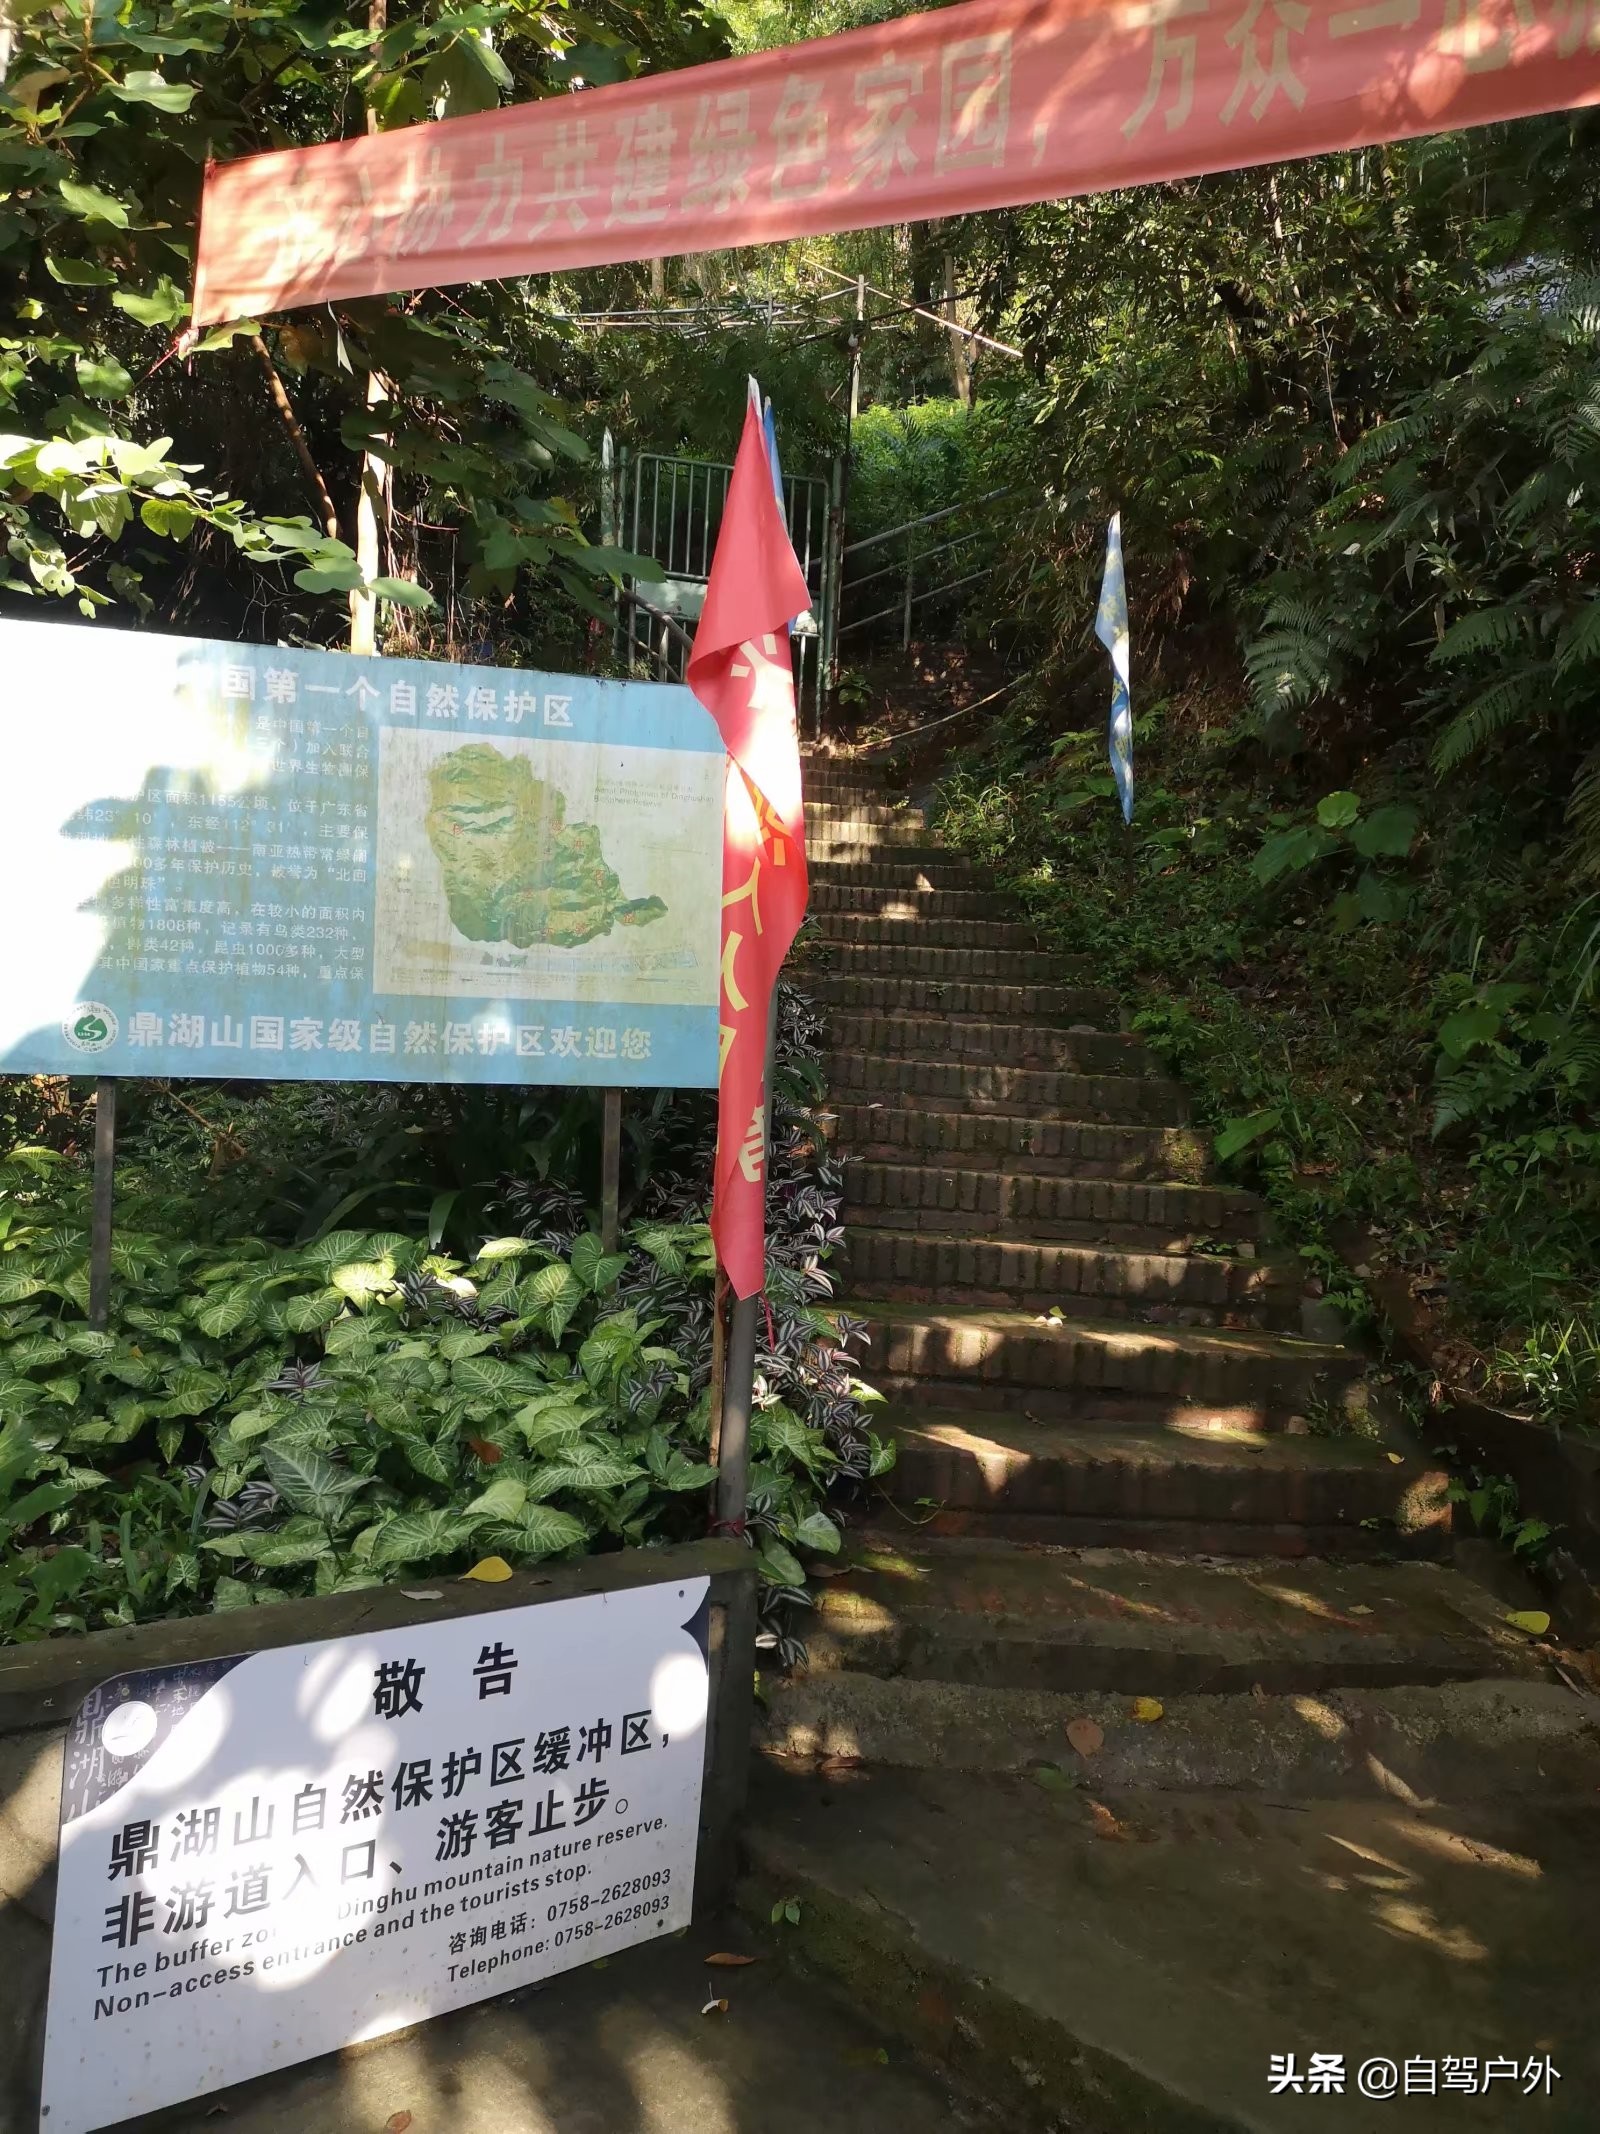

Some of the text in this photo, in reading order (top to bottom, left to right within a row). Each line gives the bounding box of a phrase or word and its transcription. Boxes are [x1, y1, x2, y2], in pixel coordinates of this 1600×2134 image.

[220, 664, 574, 727] 国第一个自然保护区
[127, 1011, 652, 1060] 鼎湖山国家级自然保护区欢迎您
[107, 1709, 669, 1881] 鼎湖山自然保护区缓冲区，
[97, 1962, 148, 1988] The
[155, 1936, 234, 1972] buffer
[338, 1885, 418, 1921] Dinghu
[424, 1854, 524, 1898] mountain
[529, 1839, 592, 1867] nature
[597, 1816, 668, 1847] reserve.
[447, 1894, 671, 1982] Telephone: 0758-2628093
[547, 1867, 672, 1922] 0758-2628093
[93, 1861, 593, 2021] Non-access entrance and the tourists stop.
